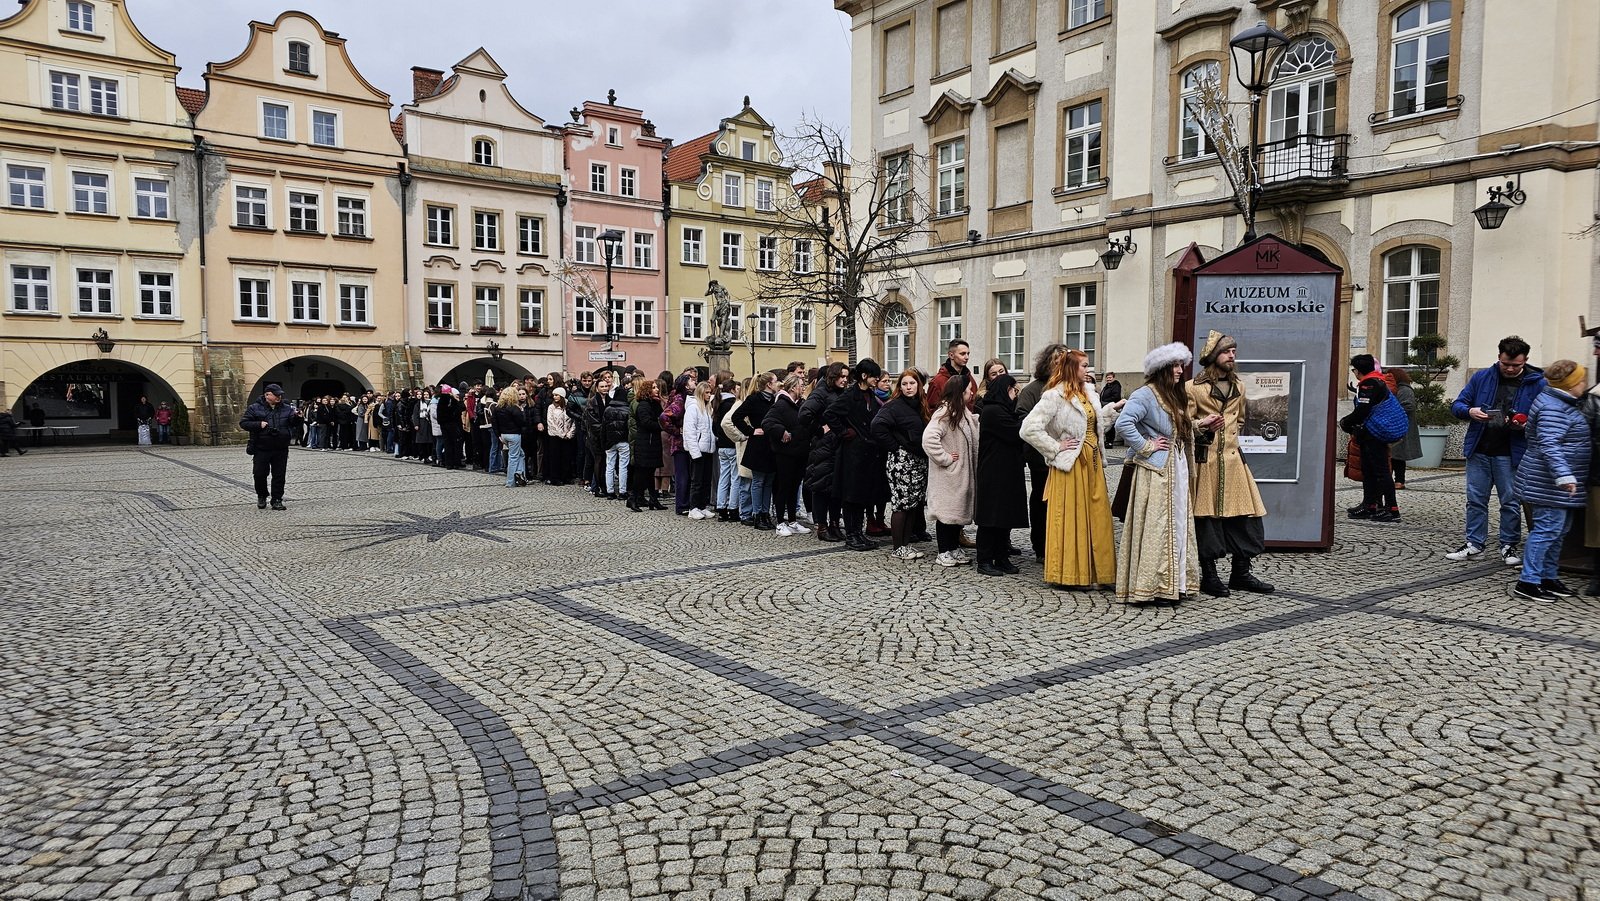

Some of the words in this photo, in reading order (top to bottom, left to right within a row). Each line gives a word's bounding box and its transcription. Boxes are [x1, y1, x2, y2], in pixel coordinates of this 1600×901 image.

[1255, 249, 1280, 263] MK
[1224, 286, 1290, 299] MUZEUM
[1205, 301, 1325, 314] Karkonoskie
